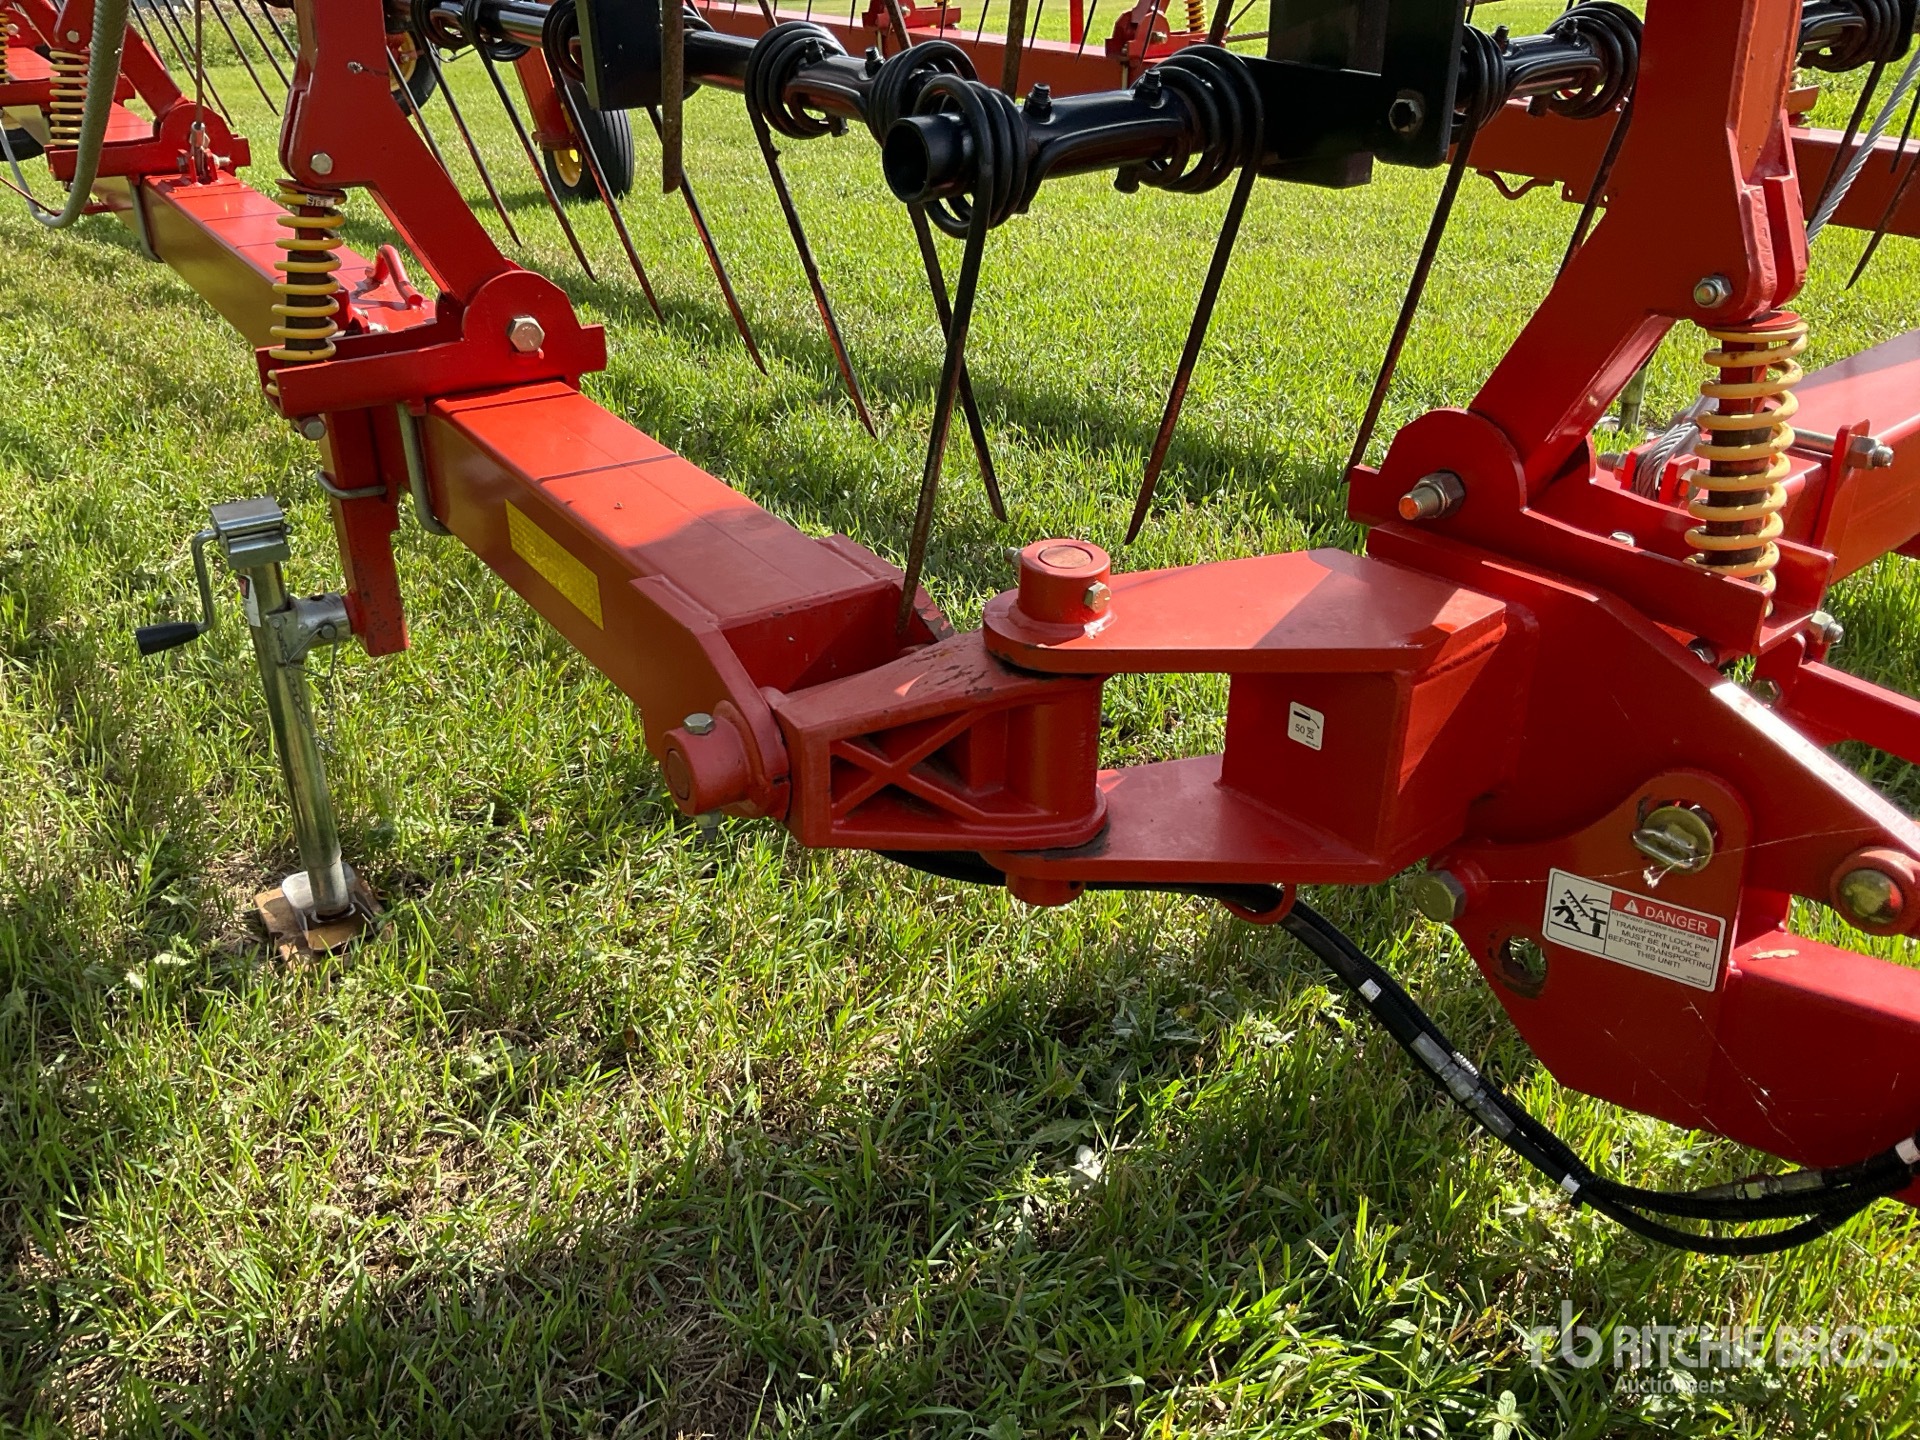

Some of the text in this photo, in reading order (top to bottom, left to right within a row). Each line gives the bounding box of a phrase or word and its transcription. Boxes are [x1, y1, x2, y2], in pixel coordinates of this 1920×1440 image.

[1295, 723, 1305, 734] 50
[1645, 906, 1708, 934] DANGER
[1615, 920, 1710, 953] TRANSPORT LOCK PIN
[1621, 930, 1701, 958] MUST BE IN PLACE
[1607, 933, 1712, 971] BEFORE TRANSPORTING
[1637, 950, 1681, 969] THIS UNIT!
